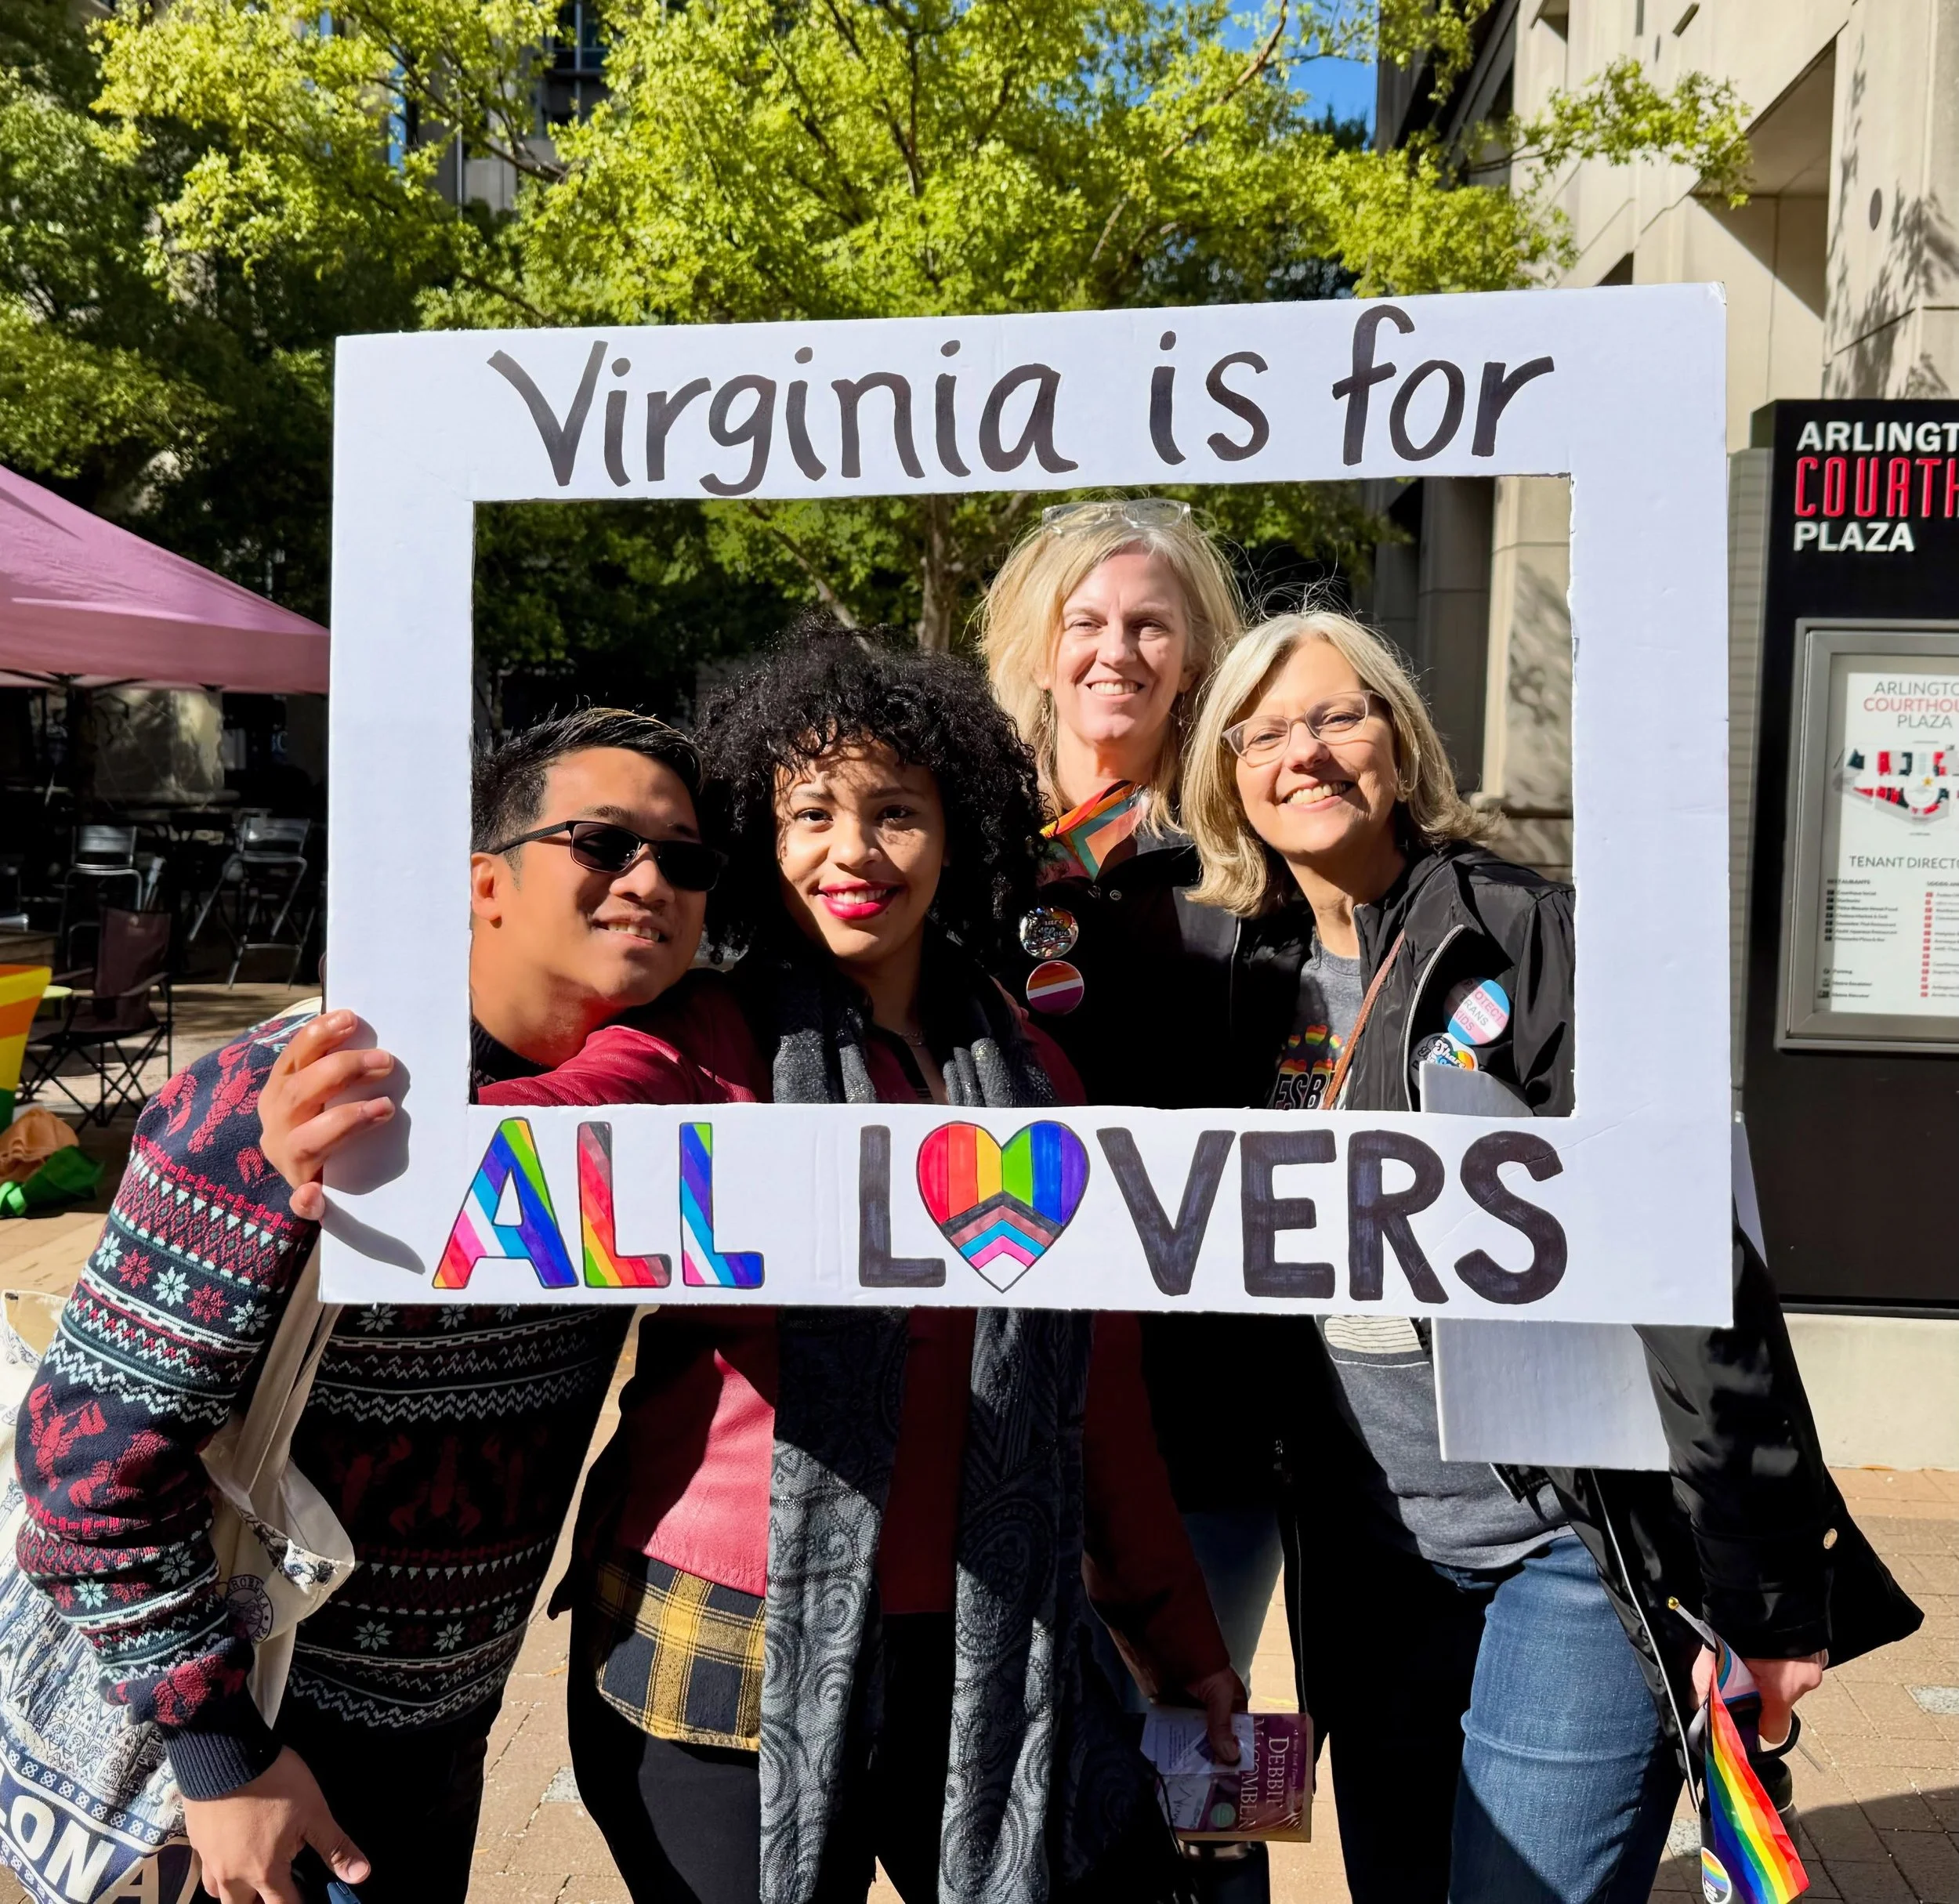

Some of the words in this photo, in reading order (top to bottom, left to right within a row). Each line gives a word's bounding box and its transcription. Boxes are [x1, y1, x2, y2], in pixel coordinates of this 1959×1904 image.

[488, 341, 1078, 498] Virginia
[1149, 331, 1269, 465] is
[1332, 304, 1555, 466] for
[1795, 420, 1959, 453] ARLINGT
[1793, 519, 1915, 552] PLAZA
[1897, 714, 1954, 729] PLAZA
[1849, 855, 1904, 868] TENANT
[1906, 857, 1959, 870] DIRECT
[431, 1117, 766, 1290] ALL
